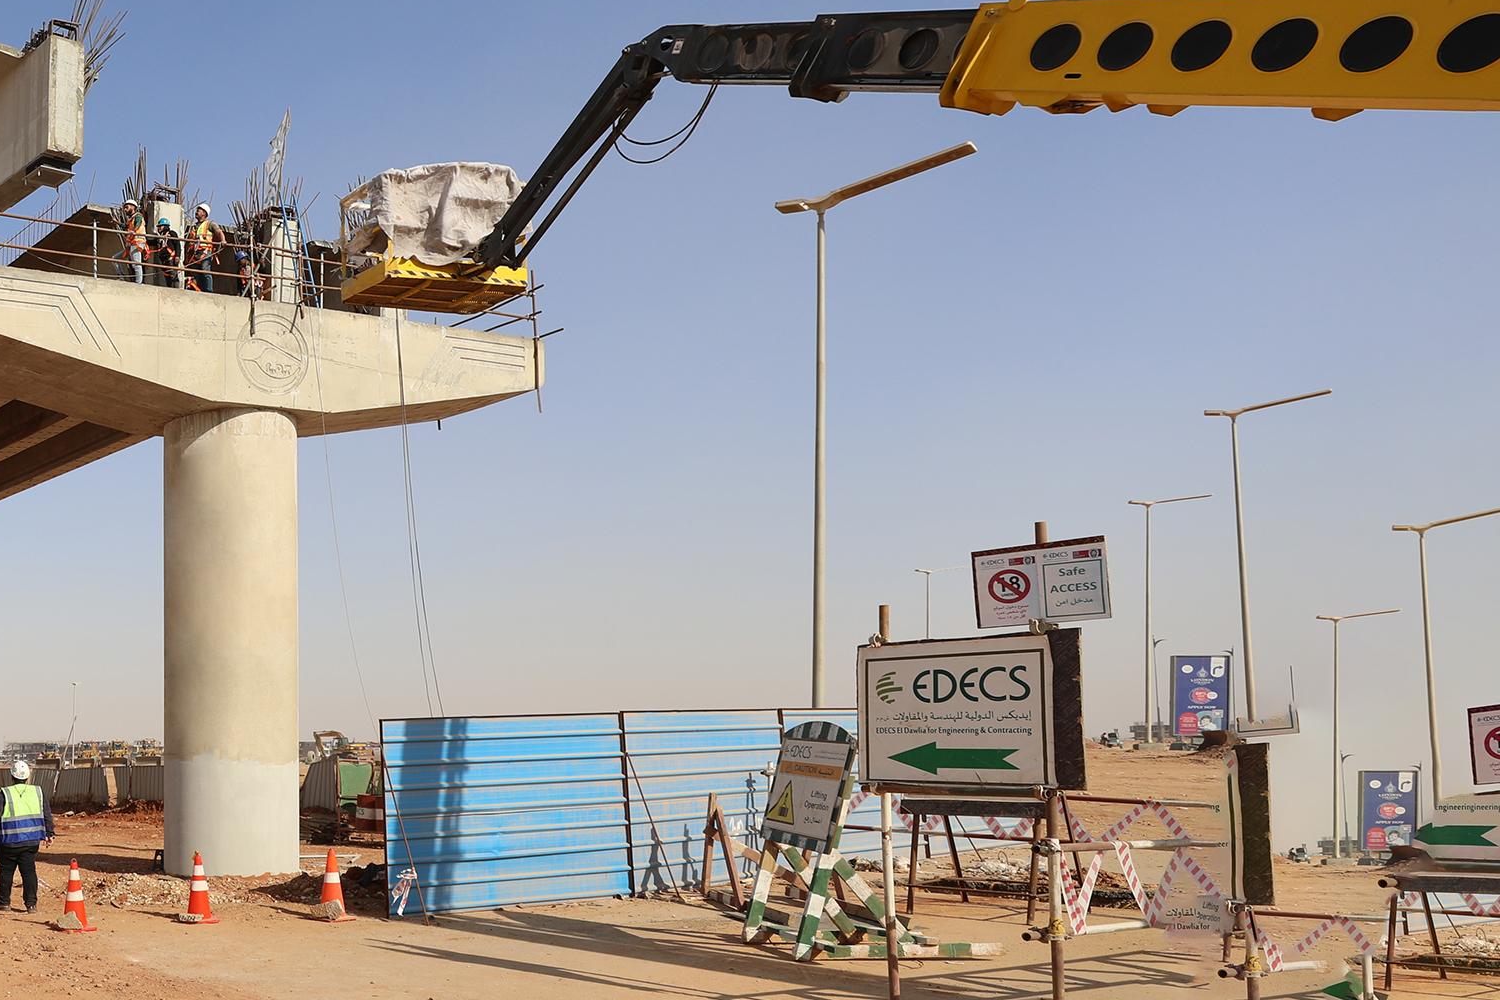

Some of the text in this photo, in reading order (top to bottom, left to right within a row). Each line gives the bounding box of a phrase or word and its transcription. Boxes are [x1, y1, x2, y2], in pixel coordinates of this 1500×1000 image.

[1058, 566, 1086, 577] Safe
[997, 576, 1021, 592] 18
[1050, 581, 1097, 593] ACCESS
[913, 665, 1031, 703] EDECS
[893, 712, 928, 722] والمقاولات
[930, 711, 963, 722] للهندسة
[965, 710, 994, 721] الدولية
[928, 726, 937, 734] for
[939, 726, 979, 736] Engineering
[988, 726, 1032, 736] Contracting
